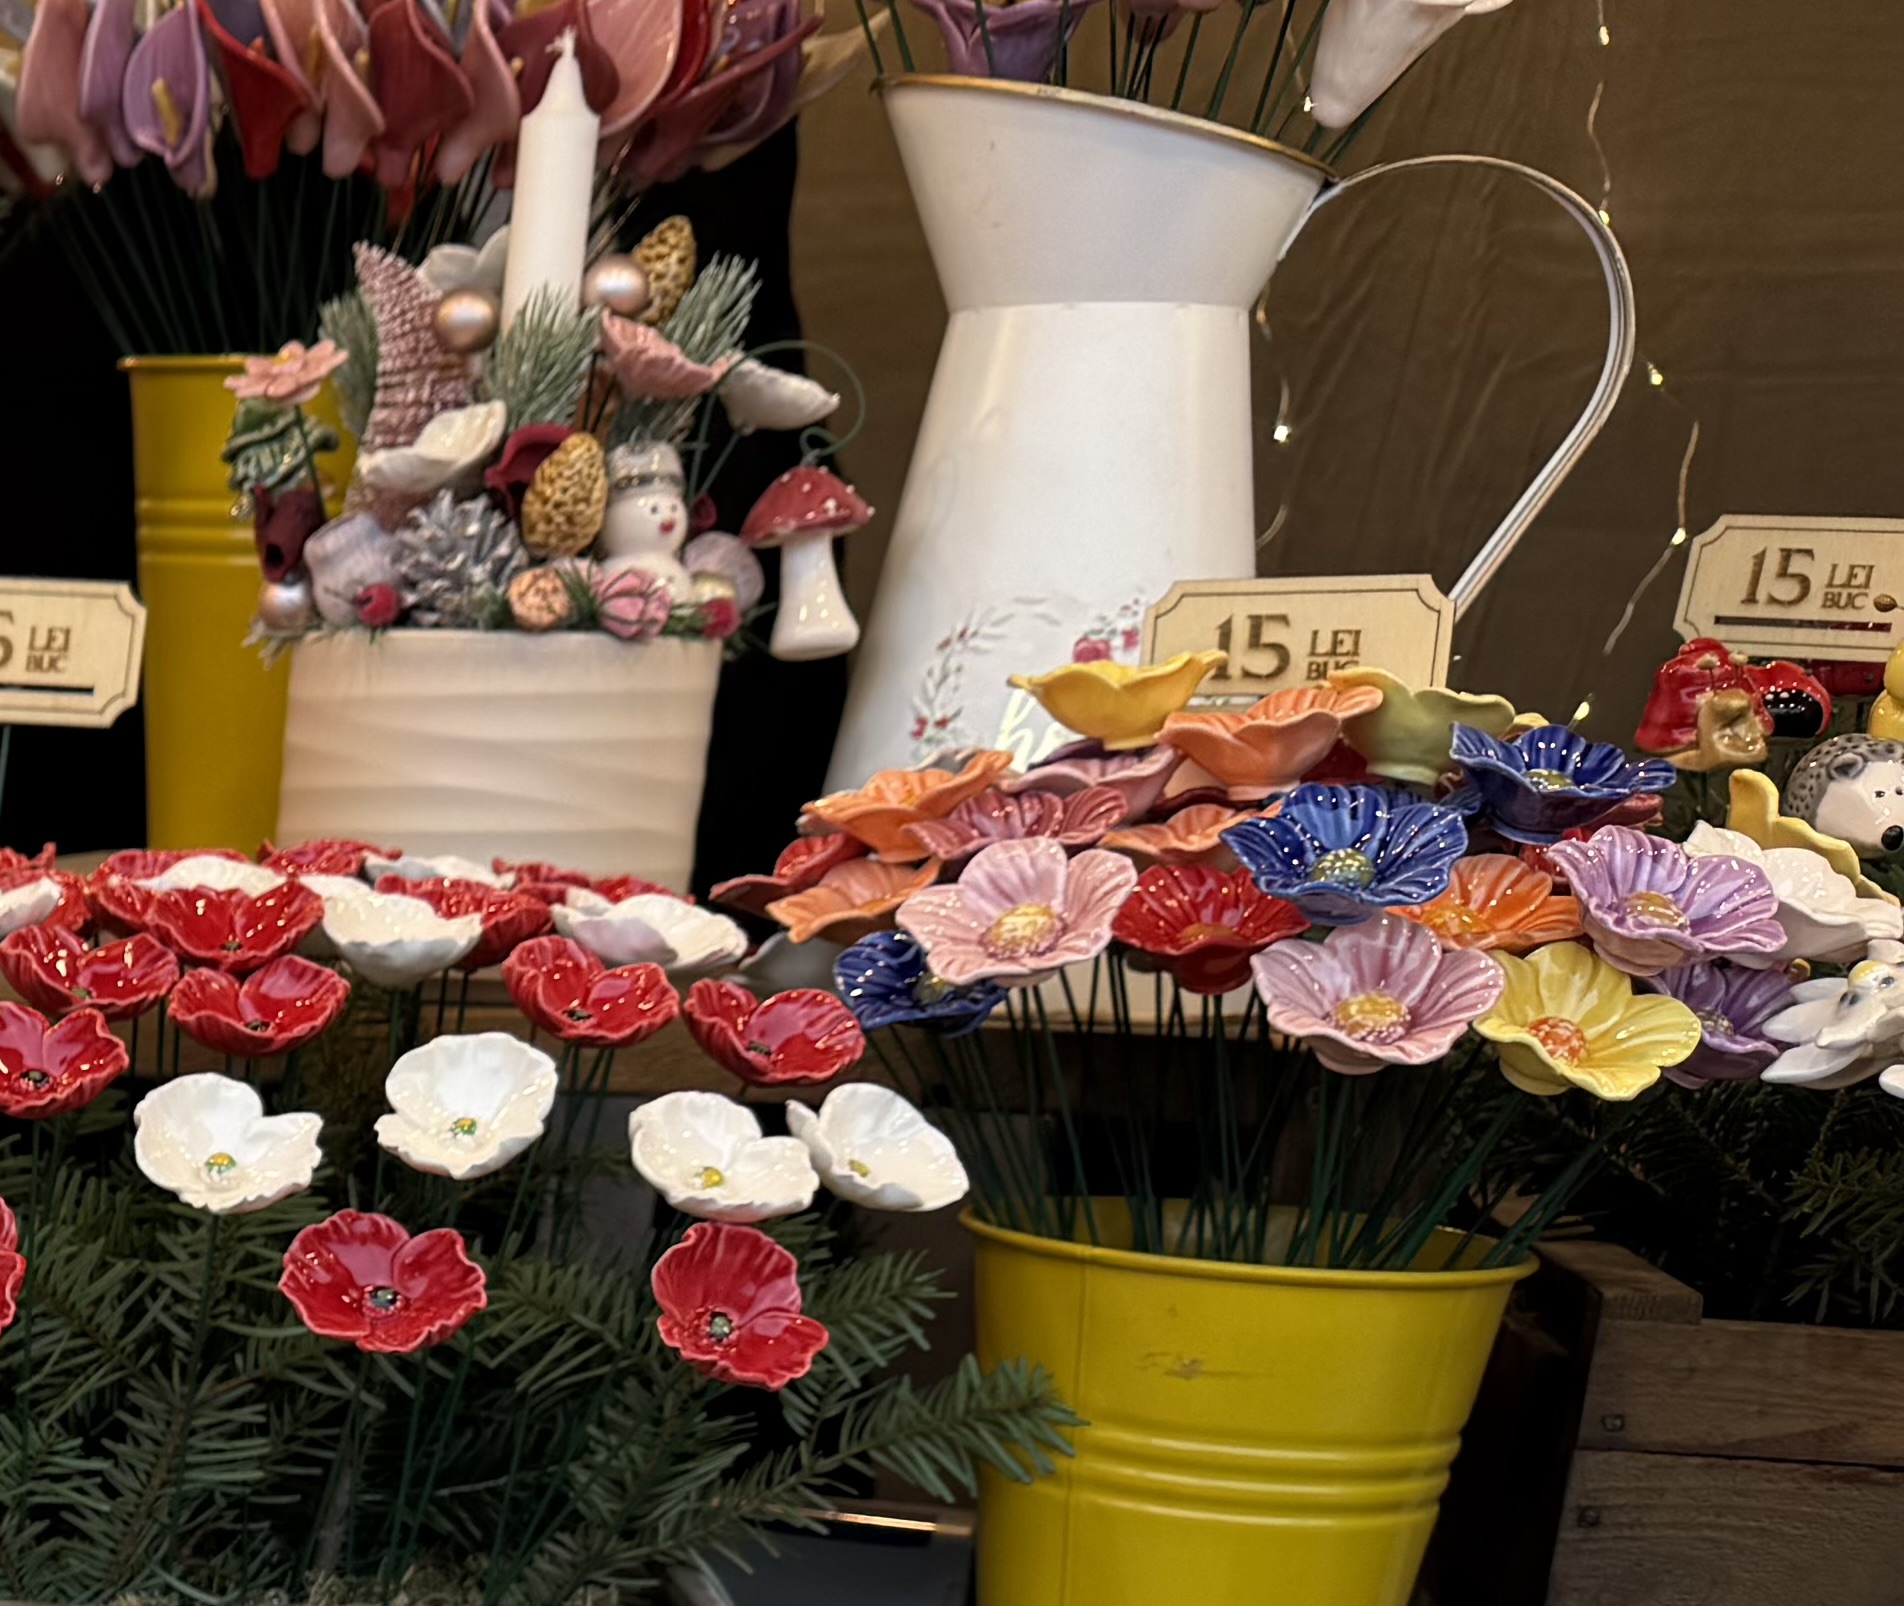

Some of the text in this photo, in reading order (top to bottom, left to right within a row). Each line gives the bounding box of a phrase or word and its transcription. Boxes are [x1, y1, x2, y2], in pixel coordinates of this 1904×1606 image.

[1740, 546, 1876, 607] 15 LEI
[1821, 591, 1869, 610] BUC
[28, 625, 72, 652] LEI
[1209, 613, 1362, 681] 15 LEI
